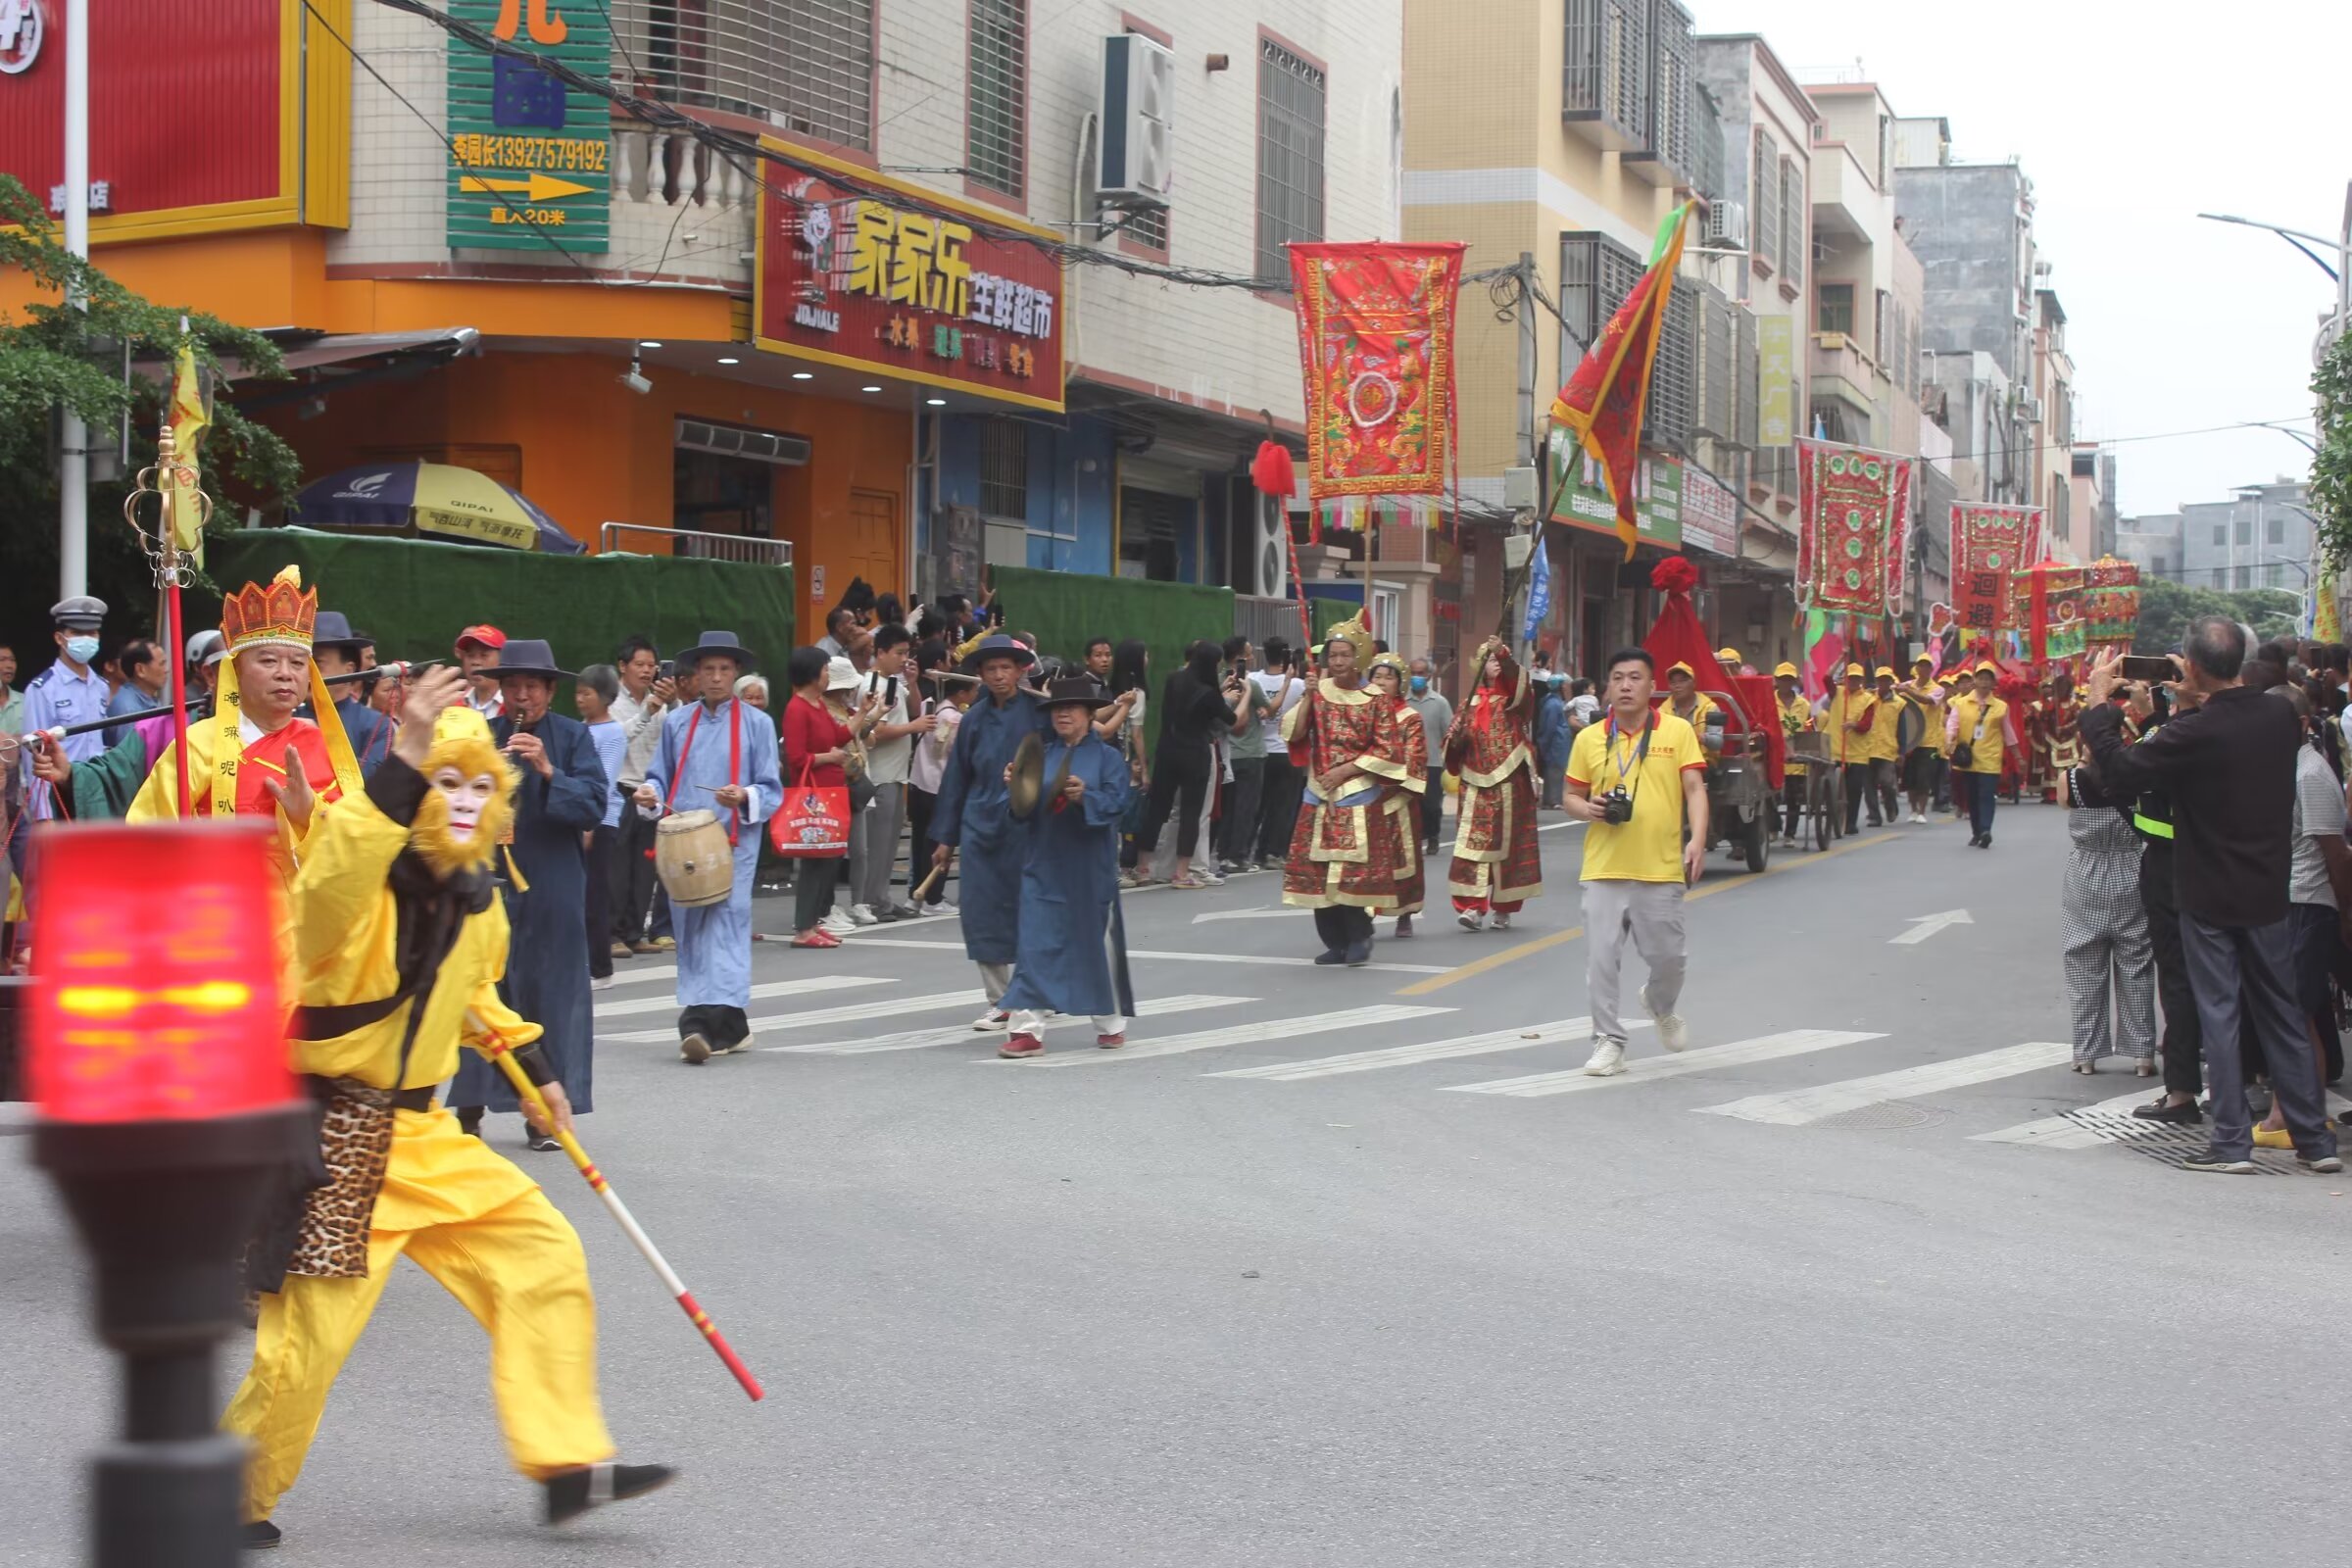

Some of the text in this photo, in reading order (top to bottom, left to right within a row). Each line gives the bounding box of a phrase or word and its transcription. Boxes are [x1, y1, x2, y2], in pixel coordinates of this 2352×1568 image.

[849, 199, 1054, 339] 家家乐 生鲜超市
[450, 500, 494, 513] QIPAI
